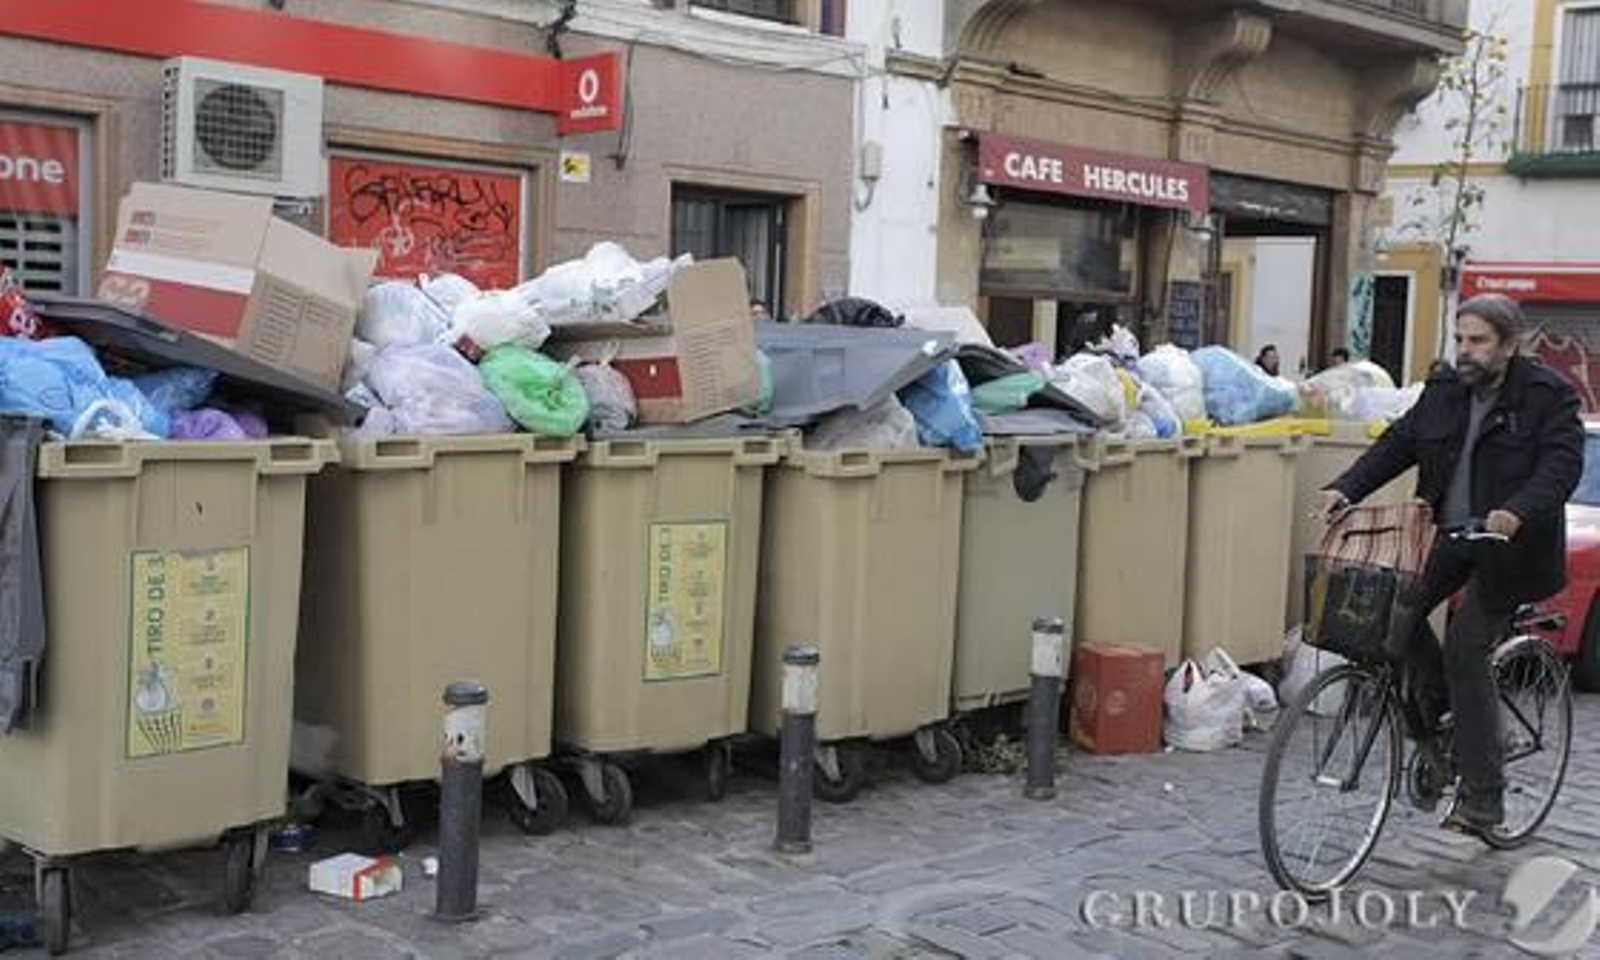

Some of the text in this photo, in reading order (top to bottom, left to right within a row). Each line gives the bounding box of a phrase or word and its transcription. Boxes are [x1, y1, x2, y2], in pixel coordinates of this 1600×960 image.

[1004, 152, 1189, 201] CAFE HERCULES
[147, 573, 165, 601] DE
[147, 607, 165, 655] TIRO
